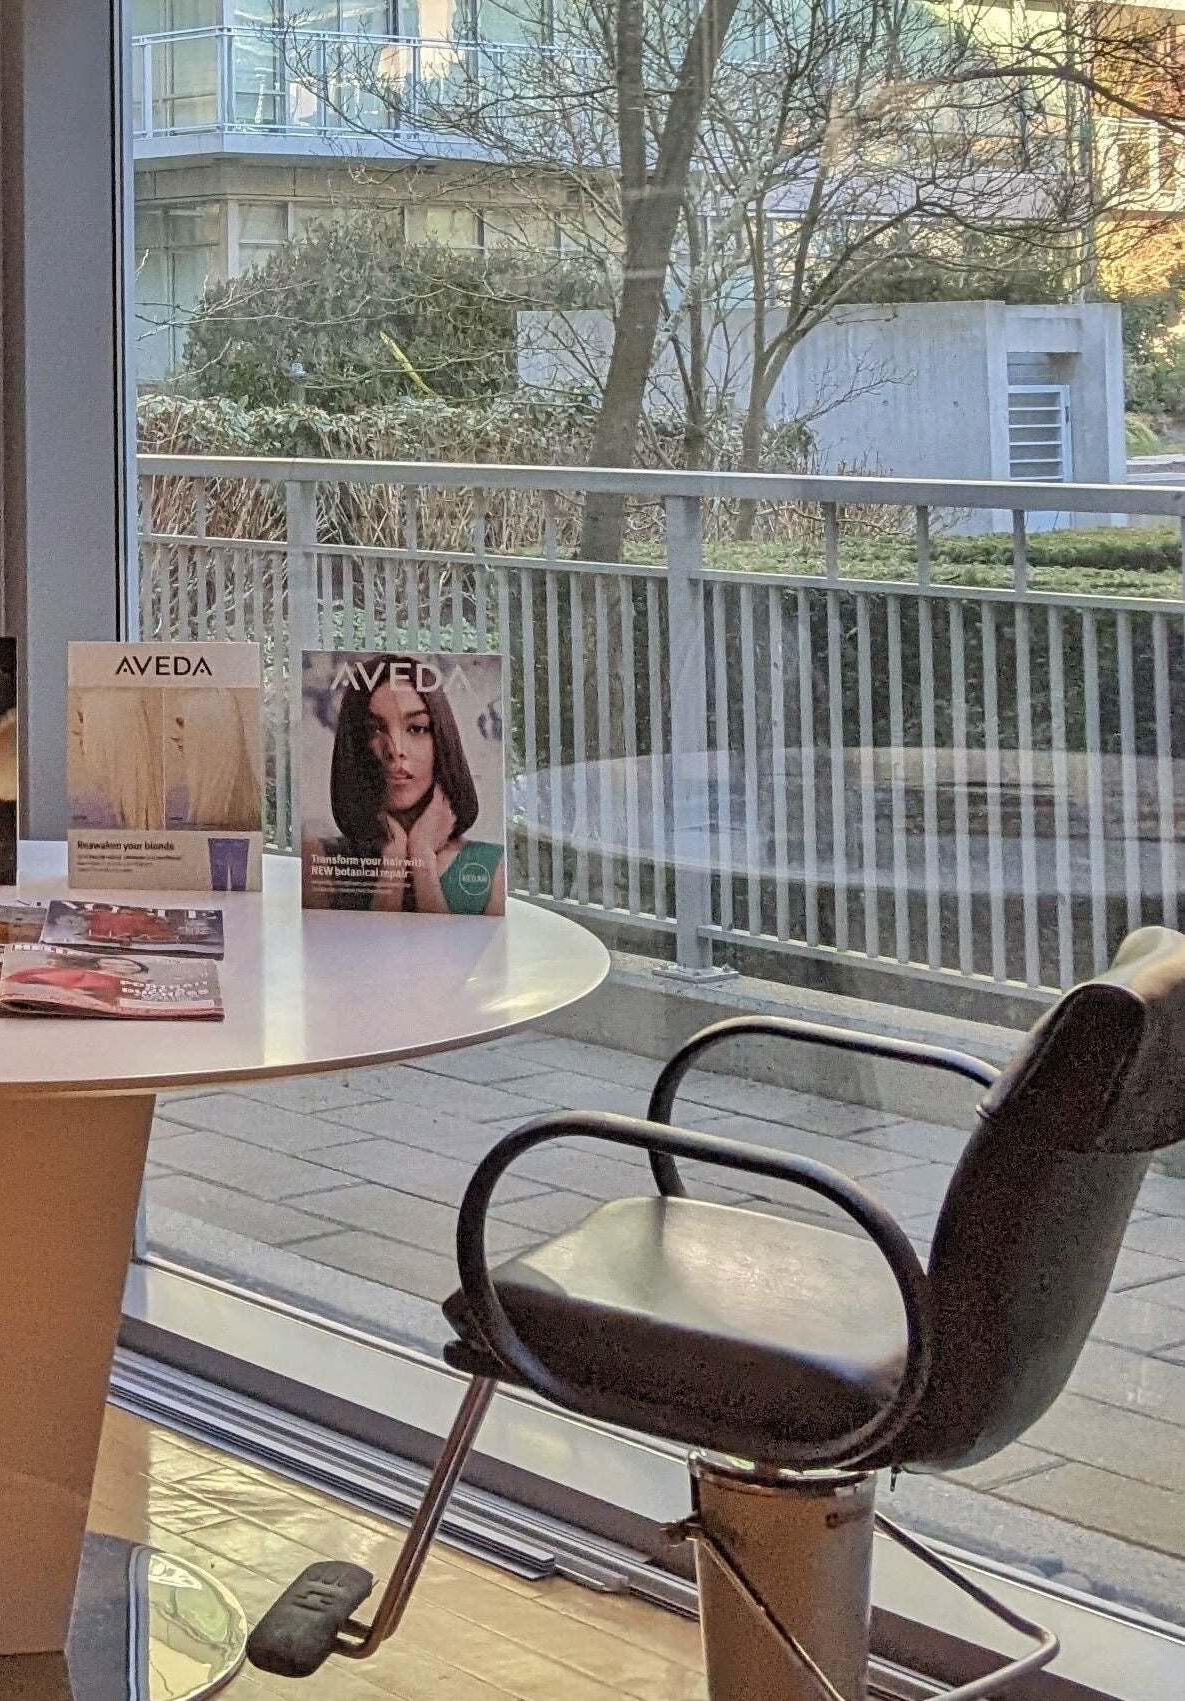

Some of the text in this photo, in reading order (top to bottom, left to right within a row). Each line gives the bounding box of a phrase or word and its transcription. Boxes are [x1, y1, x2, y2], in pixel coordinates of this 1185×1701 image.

[114, 655, 213, 677] AVEDA
[329, 661, 476, 693] AVEDA
[123, 841, 143, 853] your
[311, 854, 425, 868] Transform your hair with
[311, 865, 334, 876] NEW
[334, 866, 379, 877] botanical
